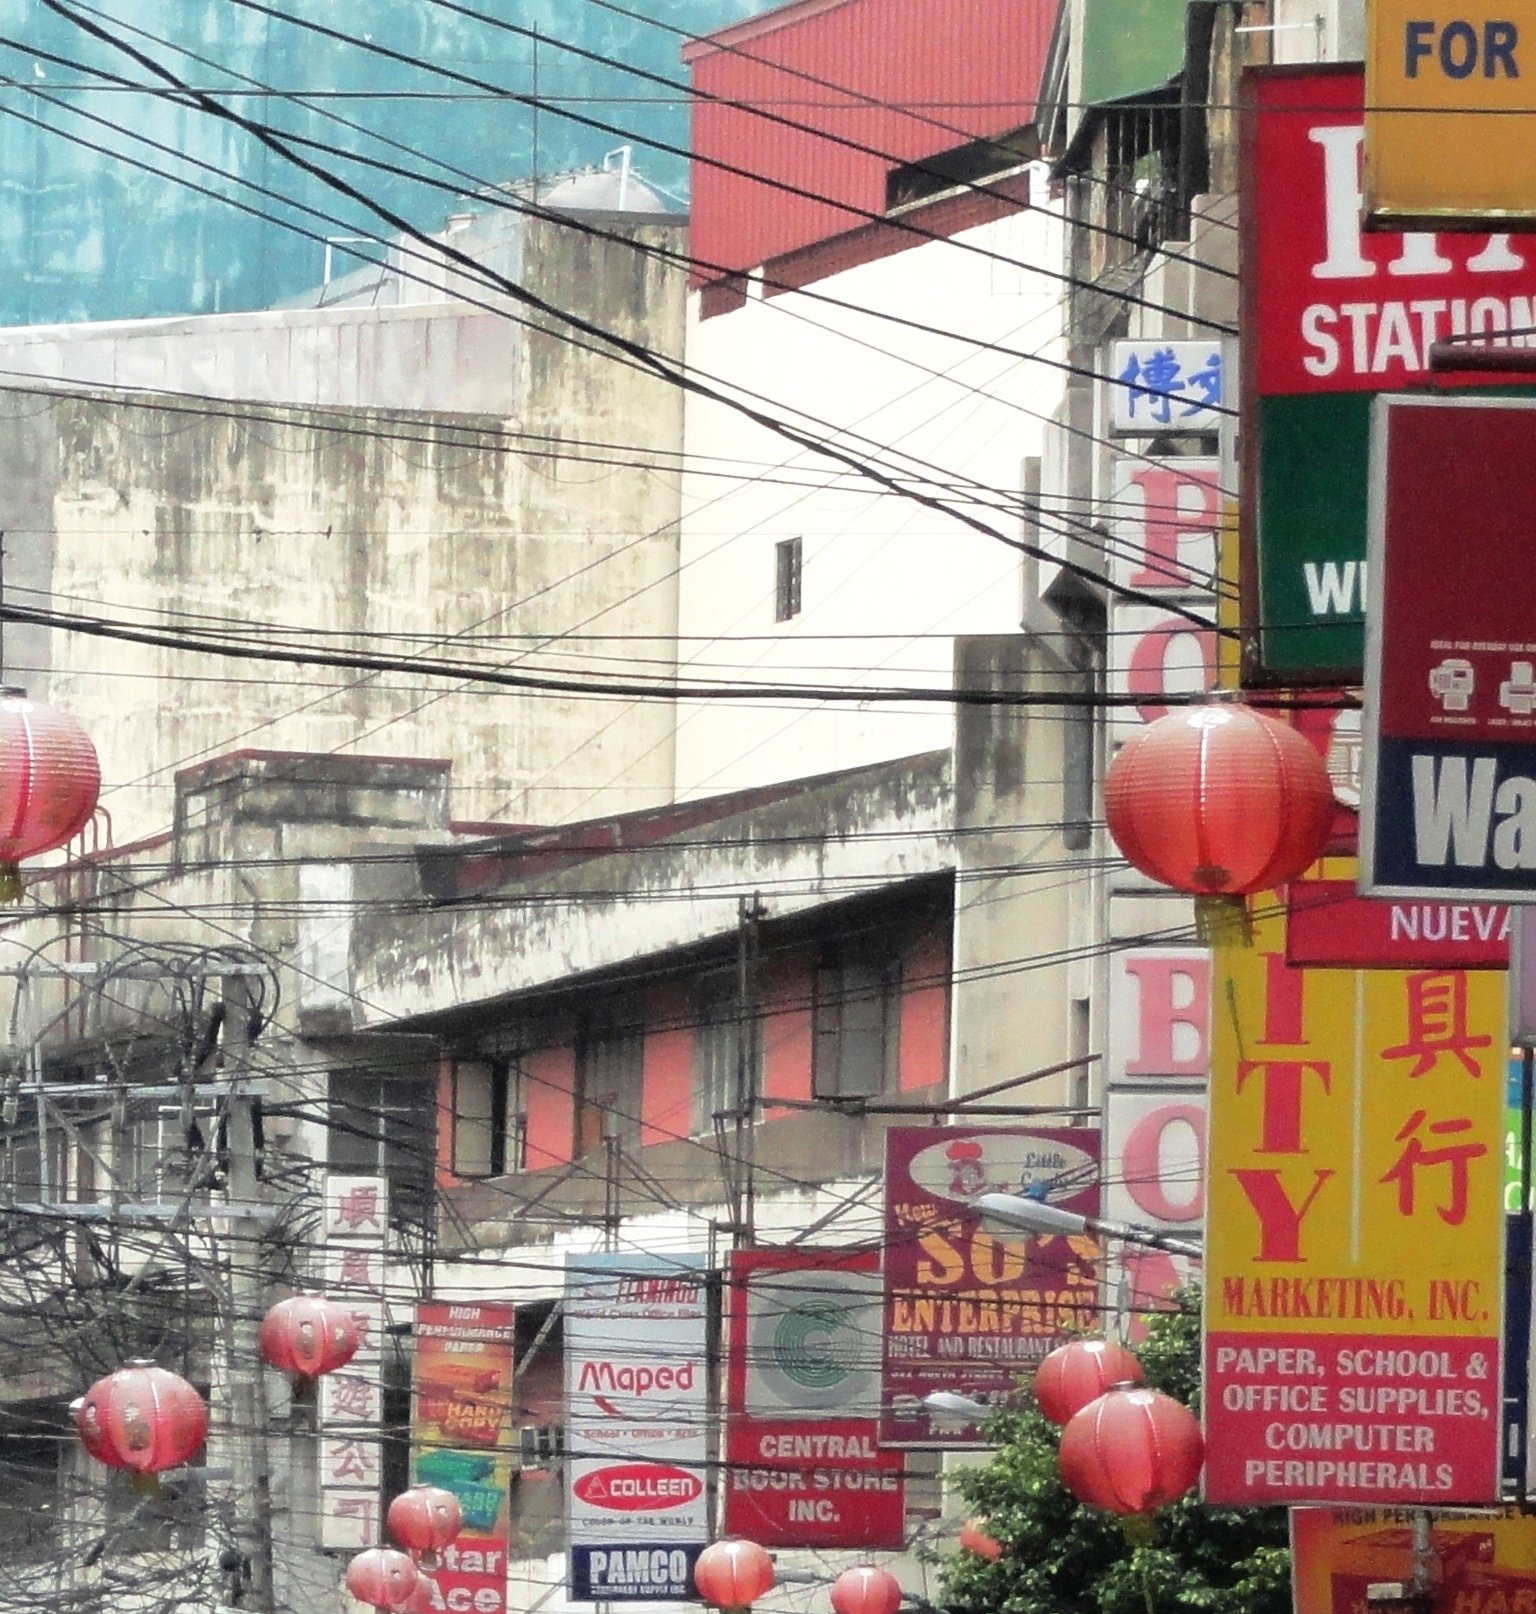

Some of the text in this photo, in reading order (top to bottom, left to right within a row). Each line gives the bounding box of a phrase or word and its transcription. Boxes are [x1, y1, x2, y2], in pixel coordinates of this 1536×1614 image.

[1405, 21, 1519, 79] FOR
[1304, 562, 1367, 615] W
[1412, 755, 1536, 870] Wa
[449, 1306, 481, 1320] HIGH
[891, 1288, 1101, 1333] ENTERPRISE
[1428, 1279, 1490, 1321] INC.
[888, 1335, 931, 1358] HOTEL
[938, 1336, 964, 1358] AND
[579, 1361, 694, 1396] Maped
[1216, 1347, 1488, 1380] PAPER, SCHOOL &
[1222, 1384, 1489, 1419] OFFICE SUPPLIES,
[759, 1434, 877, 1459] CENTRAL
[1264, 1421, 1436, 1453] COMPUTER
[609, 1477, 694, 1497] COLLEEN
[732, 1467, 899, 1491] BOOK STORE
[1244, 1459, 1454, 1490] PERIPHERALS
[787, 1499, 841, 1522] INC.
[589, 1549, 688, 1585] PAMCO
